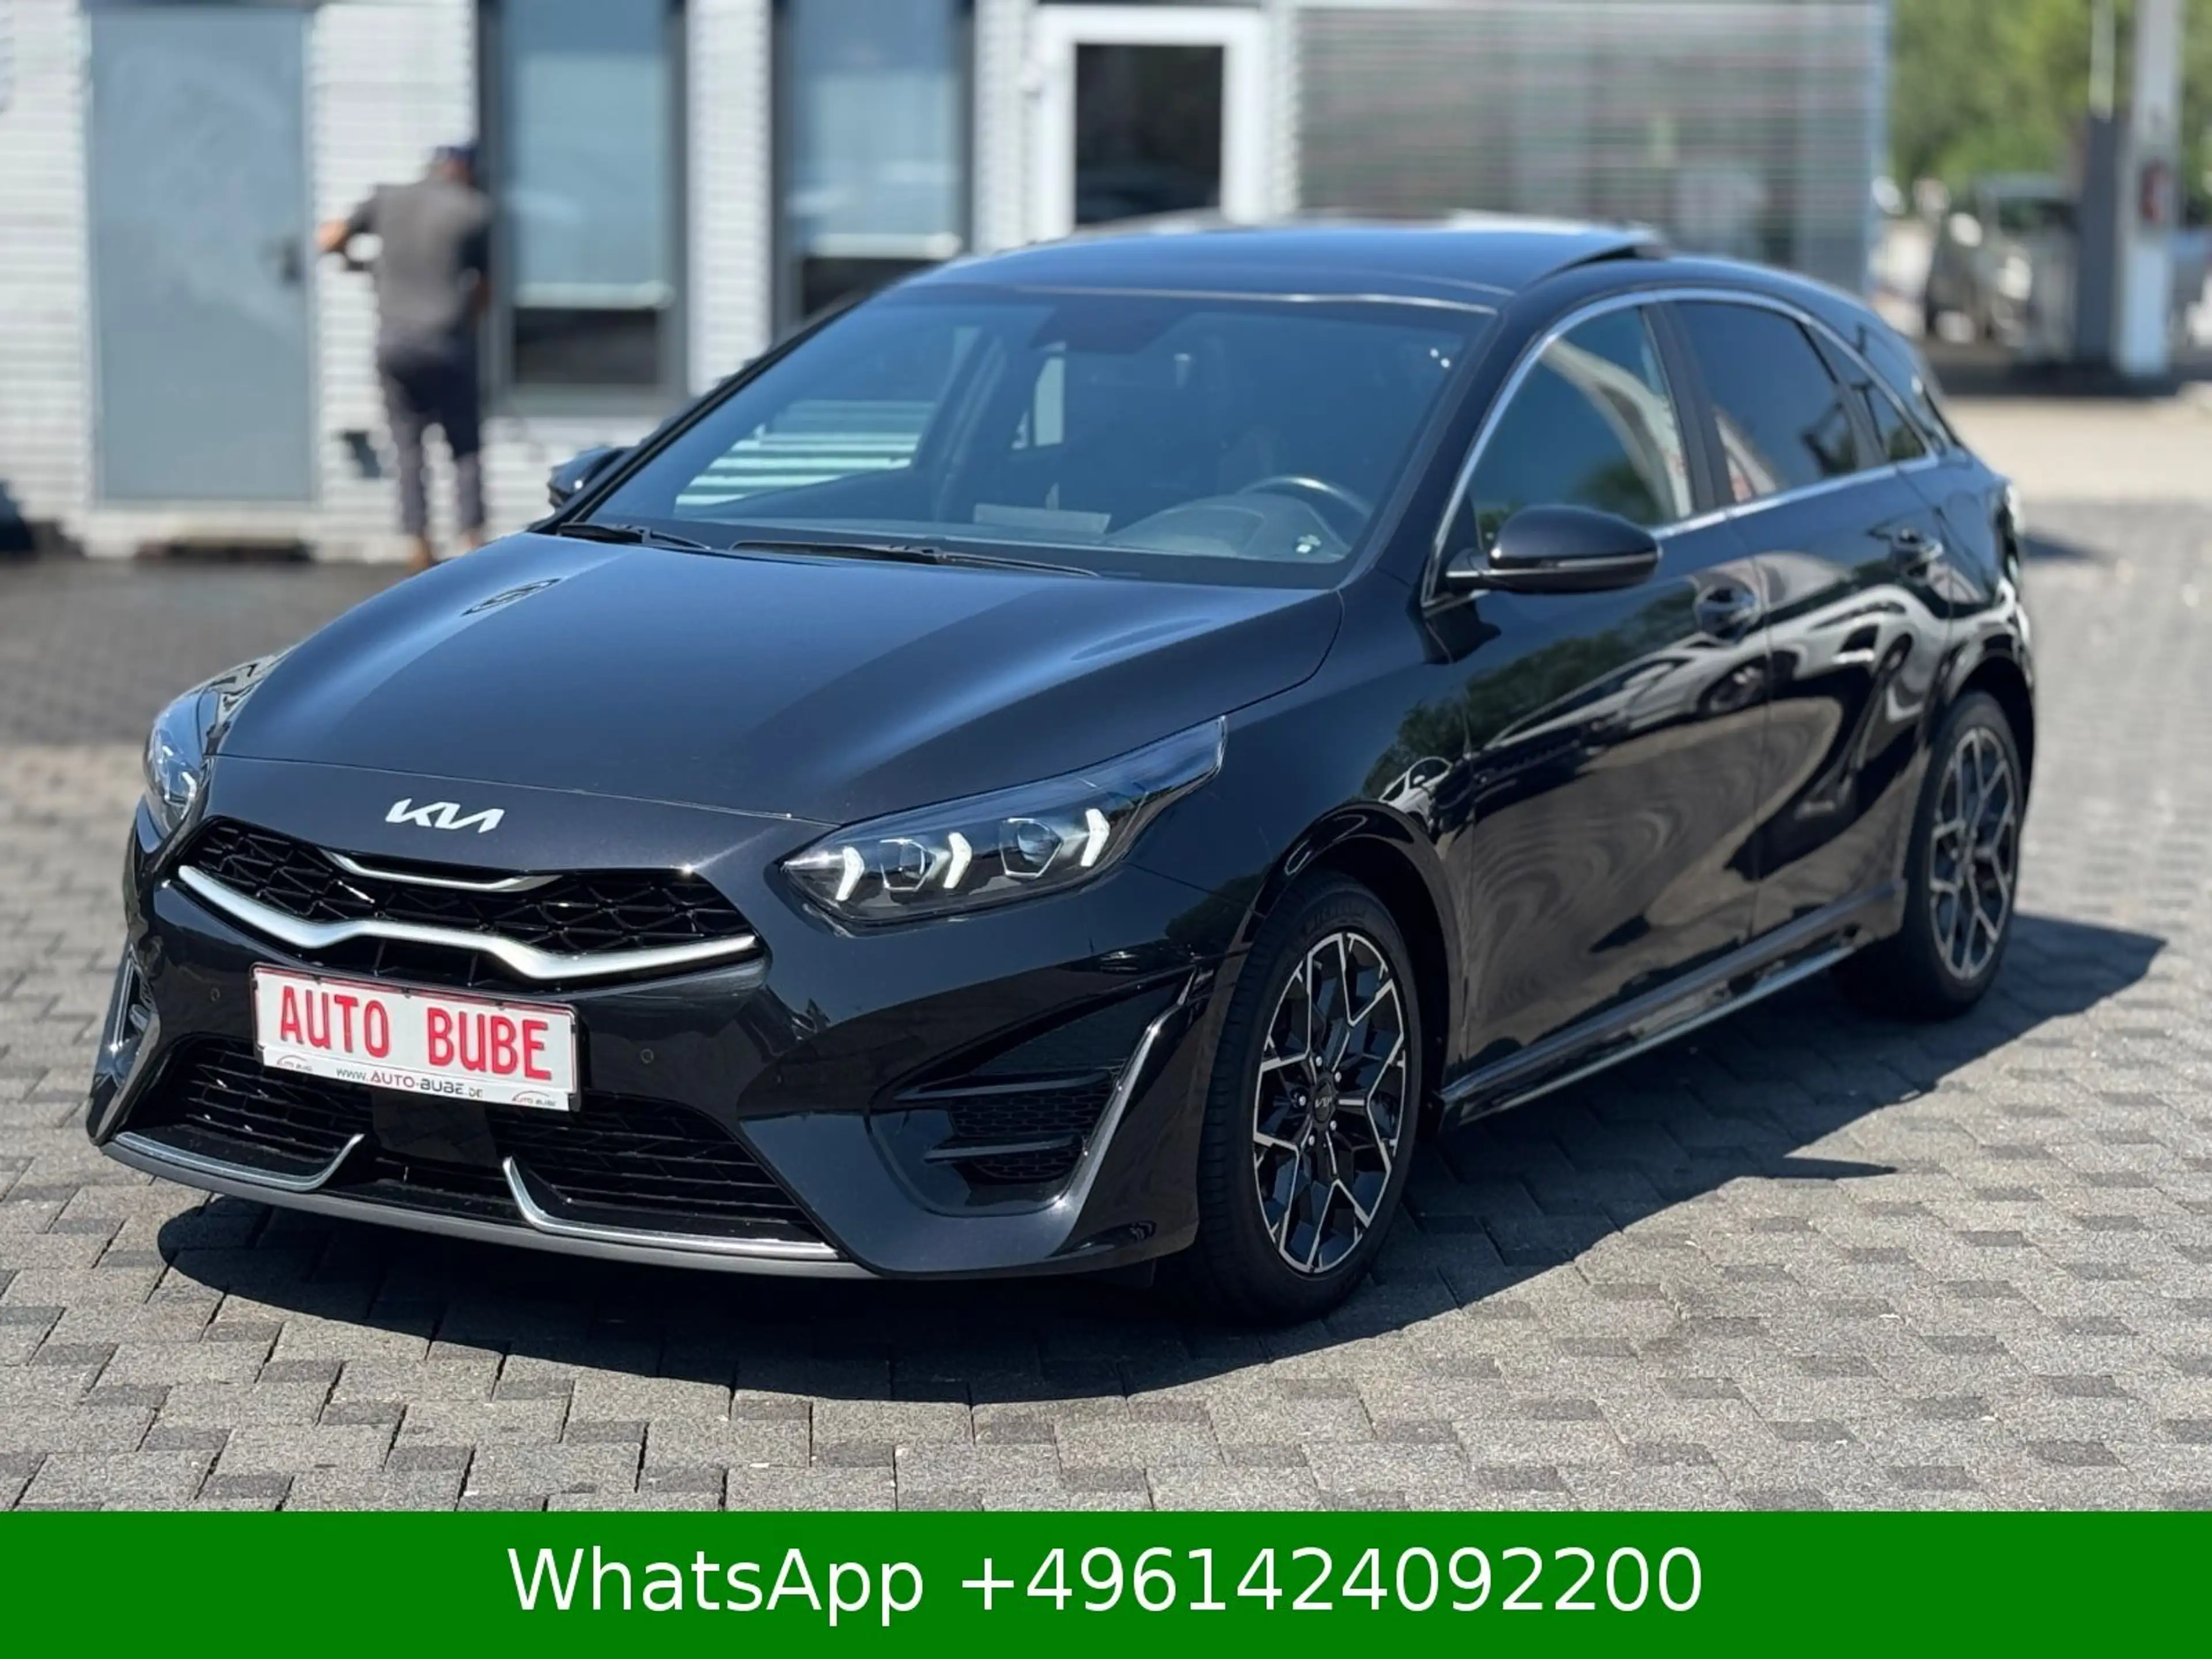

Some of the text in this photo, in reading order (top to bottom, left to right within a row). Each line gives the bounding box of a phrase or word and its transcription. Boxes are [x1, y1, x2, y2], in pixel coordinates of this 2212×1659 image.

[385, 798, 505, 833] KIA
[280, 986, 552, 1081] AUTO BUBE
